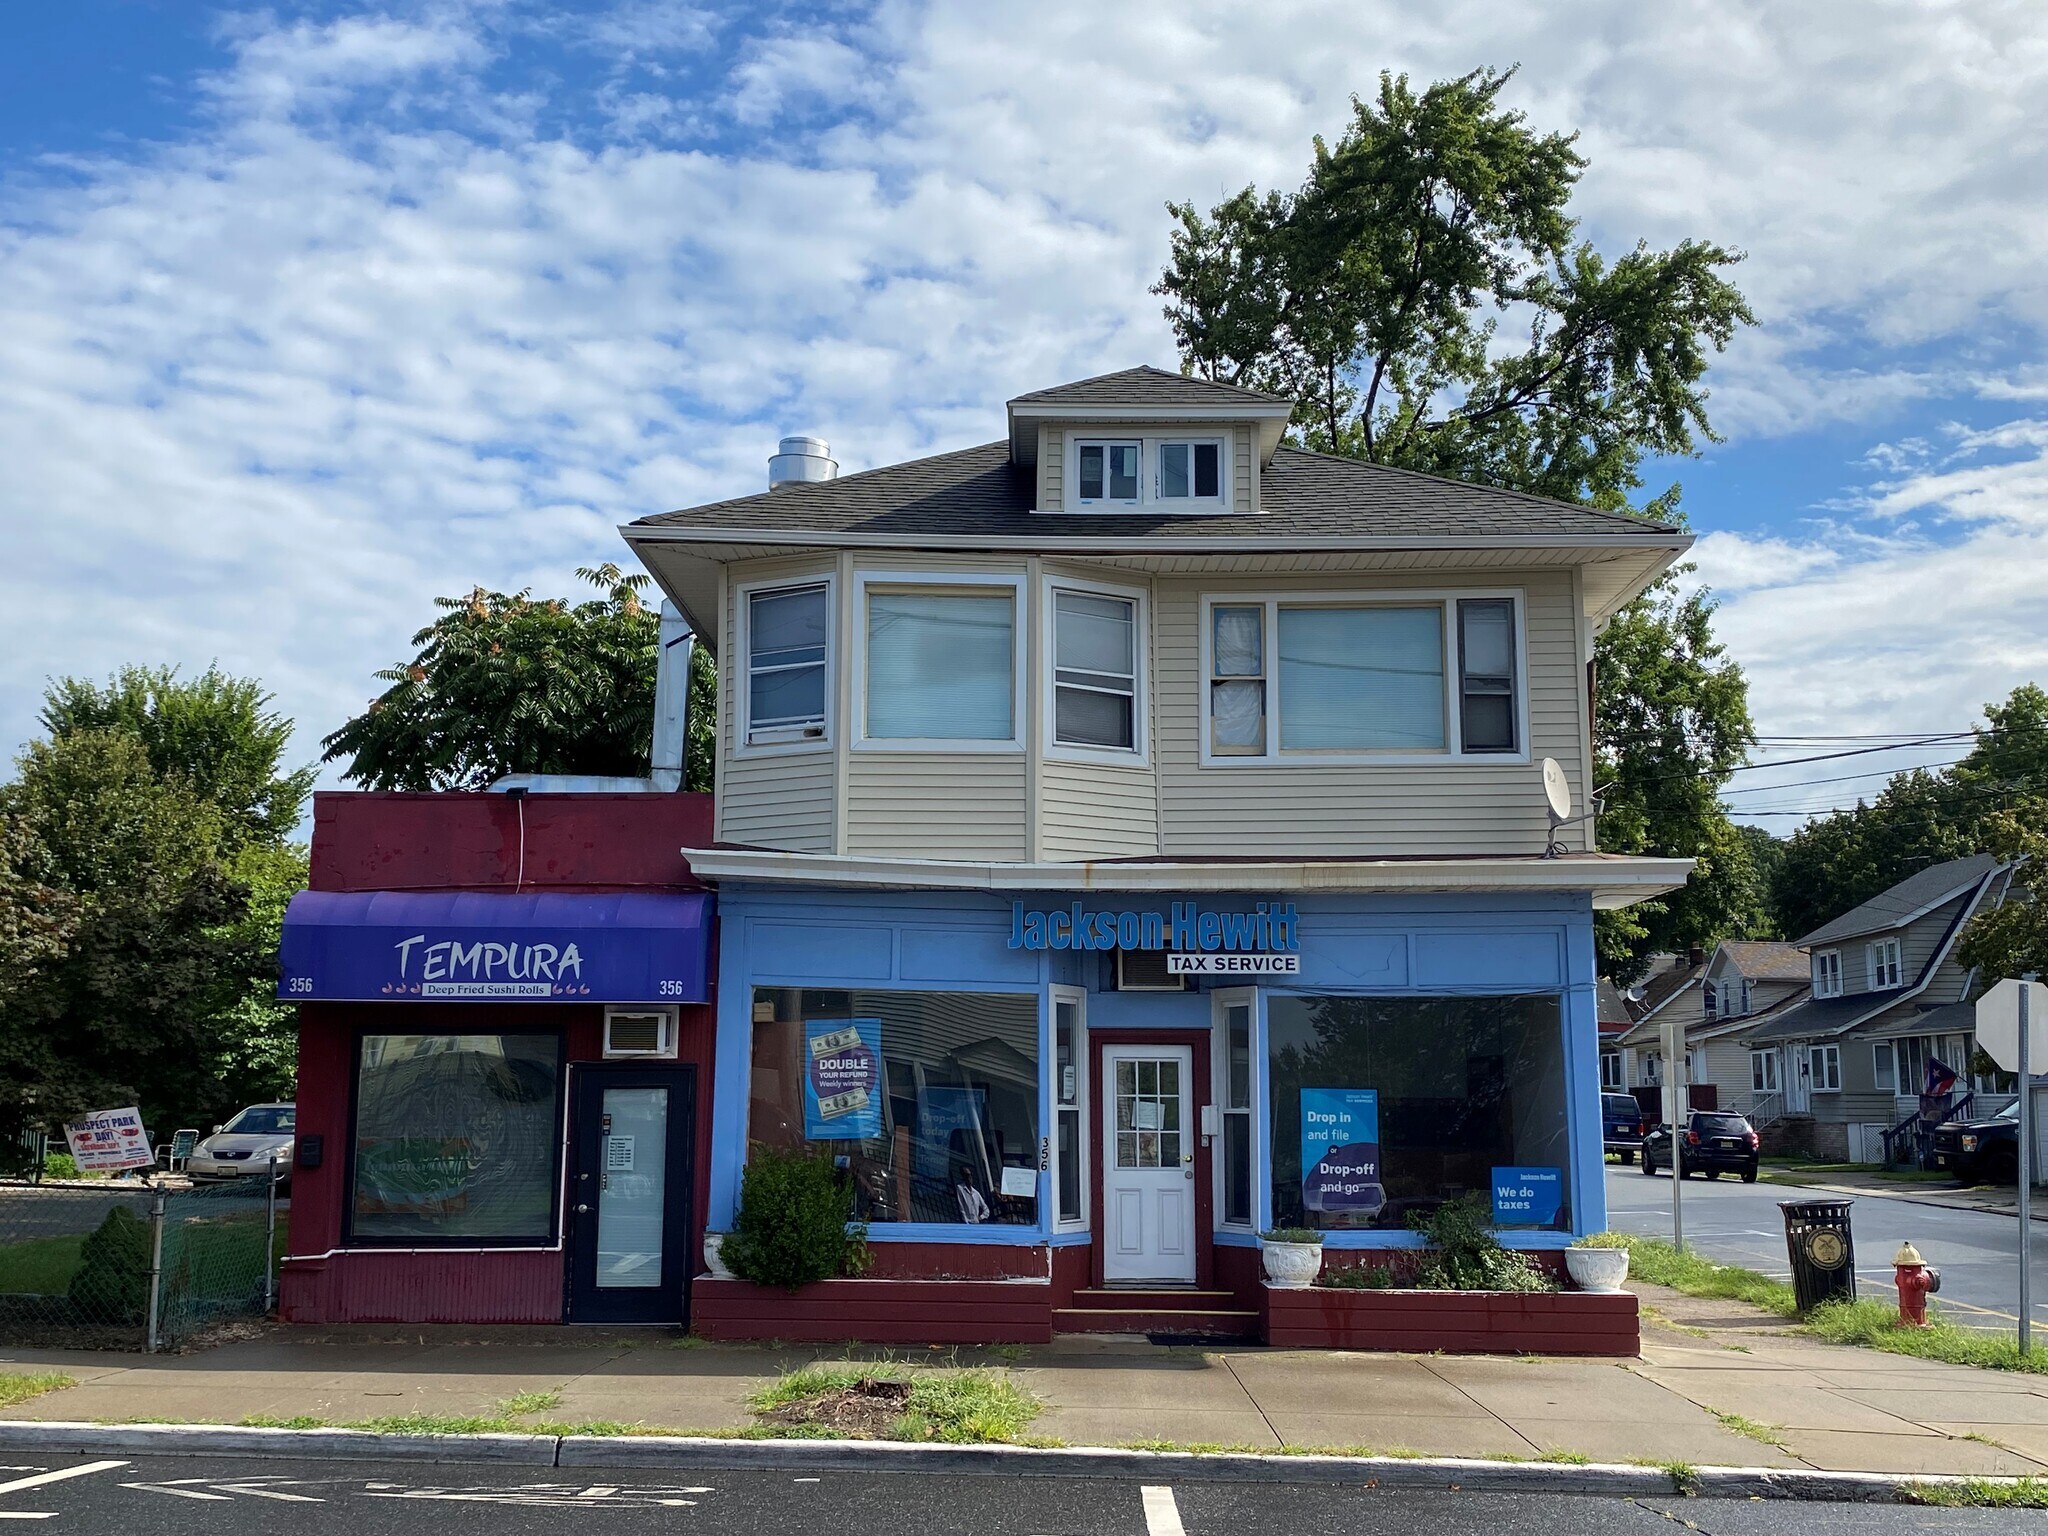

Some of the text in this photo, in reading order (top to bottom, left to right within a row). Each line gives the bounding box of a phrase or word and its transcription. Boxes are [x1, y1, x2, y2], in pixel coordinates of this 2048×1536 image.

[1008, 901, 1300, 950] Jackson Hewitt
[394, 934, 584, 981] TEMPURA
[1171, 957, 1296, 971] TAX SERVICE
[289, 977, 313, 992] 356
[427, 984, 545, 995] Deep Fried Sushi Rolls
[659, 980, 683, 995] 356
[819, 1058, 869, 1070] DOUBLE
[819, 1071, 839, 1079] YOUR
[819, 1080, 841, 1088] Weekly
[112, 1116, 136, 1127] PARK
[922, 1112, 965, 1125] Drop-off
[1307, 1111, 1351, 1125] Drop in
[921, 1127, 949, 1139] today
[1307, 1129, 1350, 1140] and file
[1040, 1137, 1049, 1171] 356
[1320, 1163, 1375, 1177] Drop-off
[1320, 1181, 1360, 1195] and go
[1497, 1186, 1534, 1197] We do
[1497, 1200, 1531, 1210] taxes
